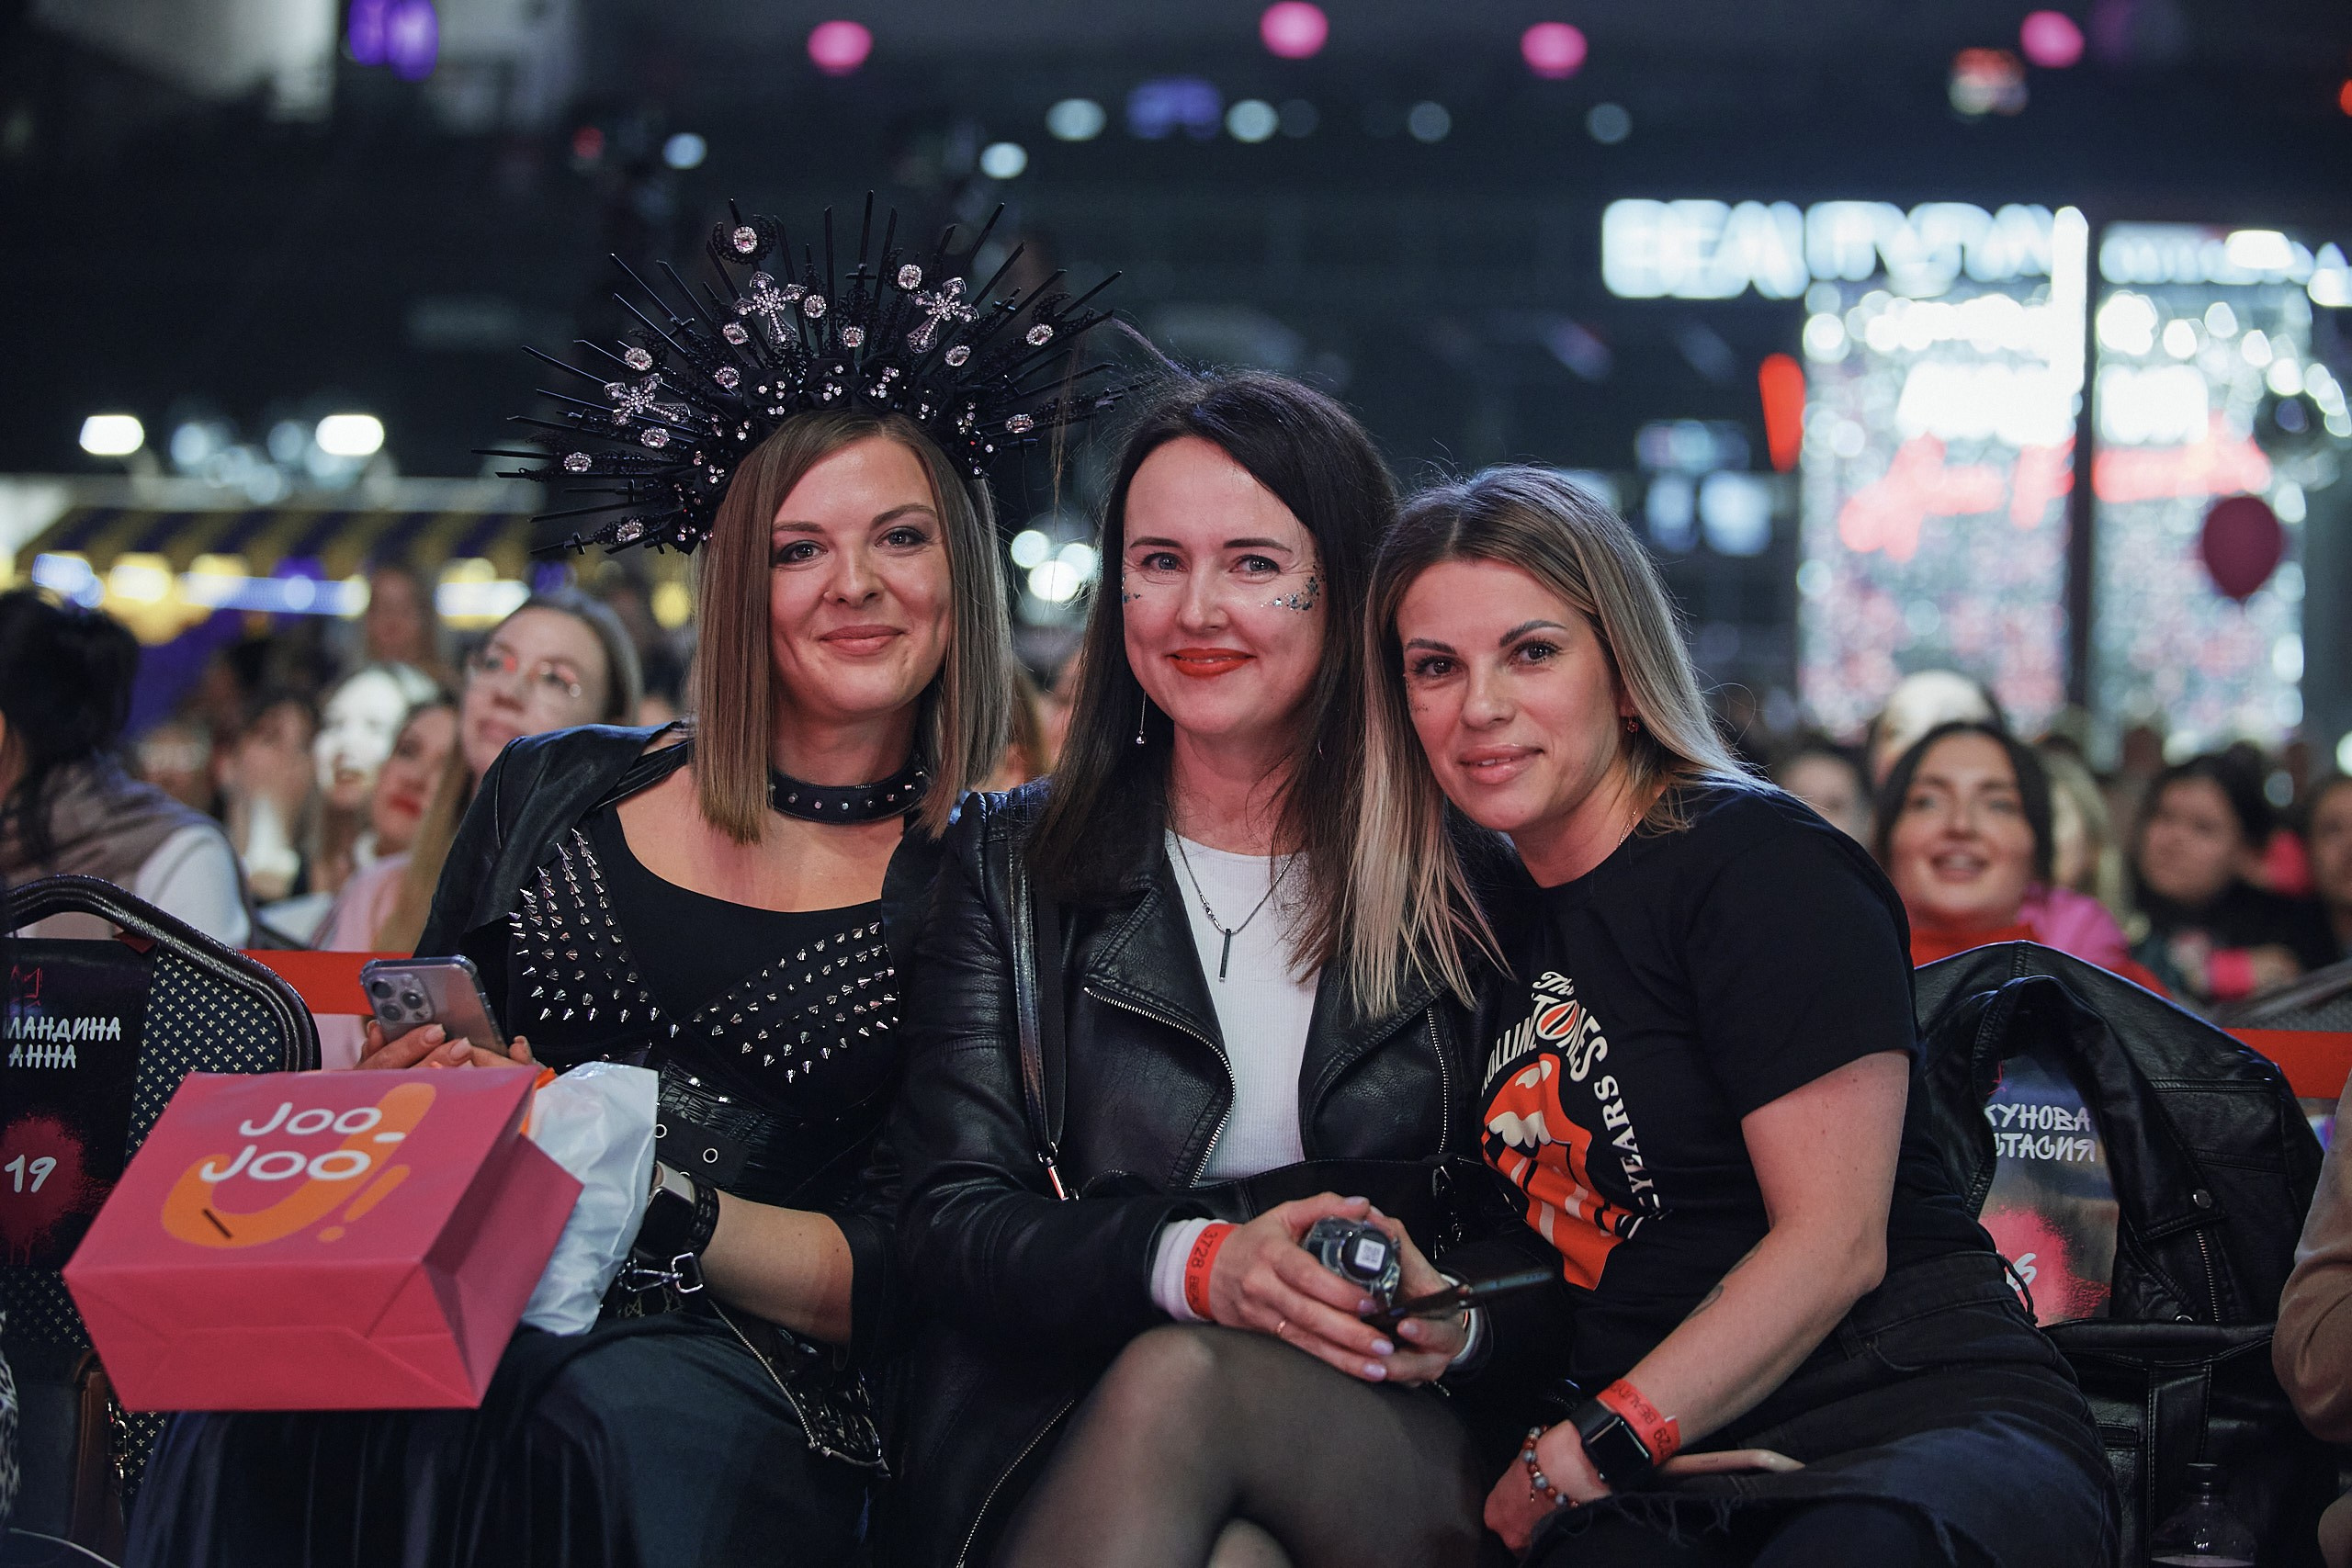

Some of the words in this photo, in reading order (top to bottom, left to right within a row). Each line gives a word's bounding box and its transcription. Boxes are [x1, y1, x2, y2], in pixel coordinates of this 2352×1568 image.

[6, 1016, 121, 1043] ЛАНДИНА
[8, 1043, 76, 1069] АННА
[5, 1154, 57, 1193] 19
[199, 1145, 372, 1182] JOO
